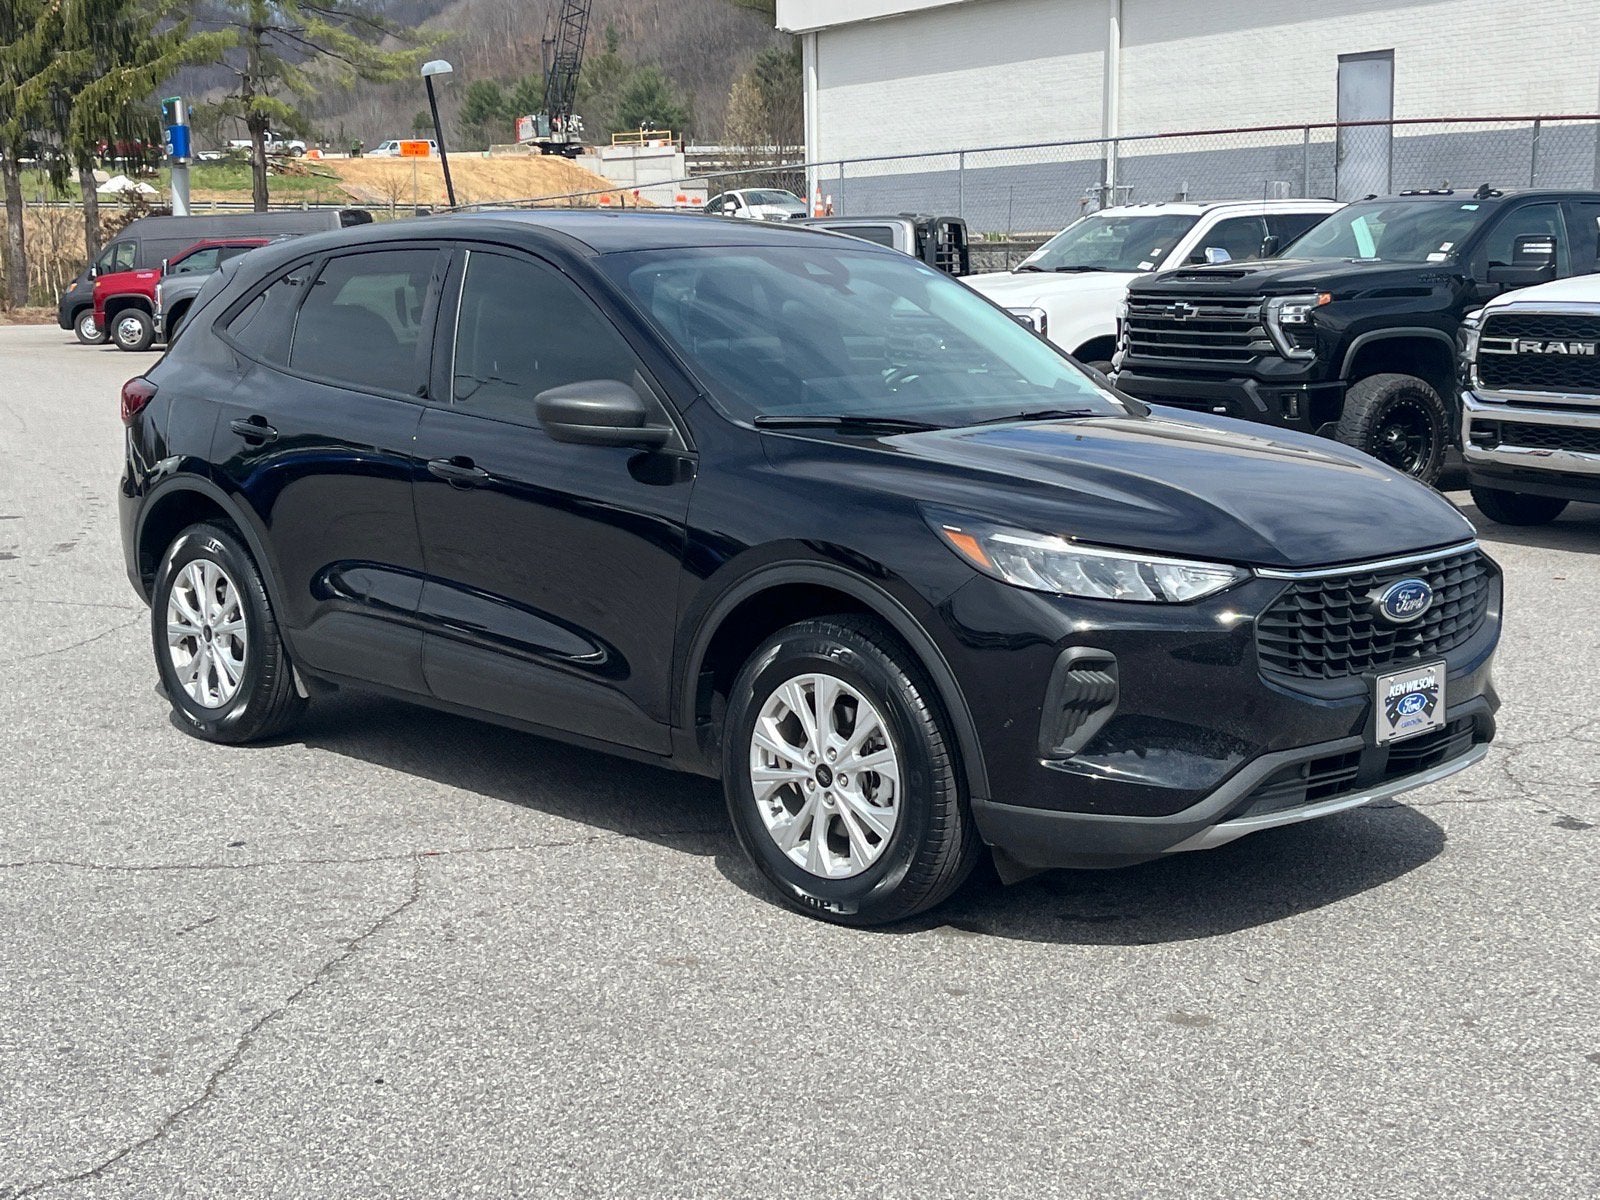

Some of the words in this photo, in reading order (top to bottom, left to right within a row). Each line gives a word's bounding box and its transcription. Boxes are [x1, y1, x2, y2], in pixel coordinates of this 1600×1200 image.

[1520, 341, 1595, 355] RAM
[1396, 589, 1425, 613] Ford
[1389, 682, 1406, 697] KEN
[1405, 676, 1435, 693] WILSON
[1403, 697, 1422, 713] Ford
